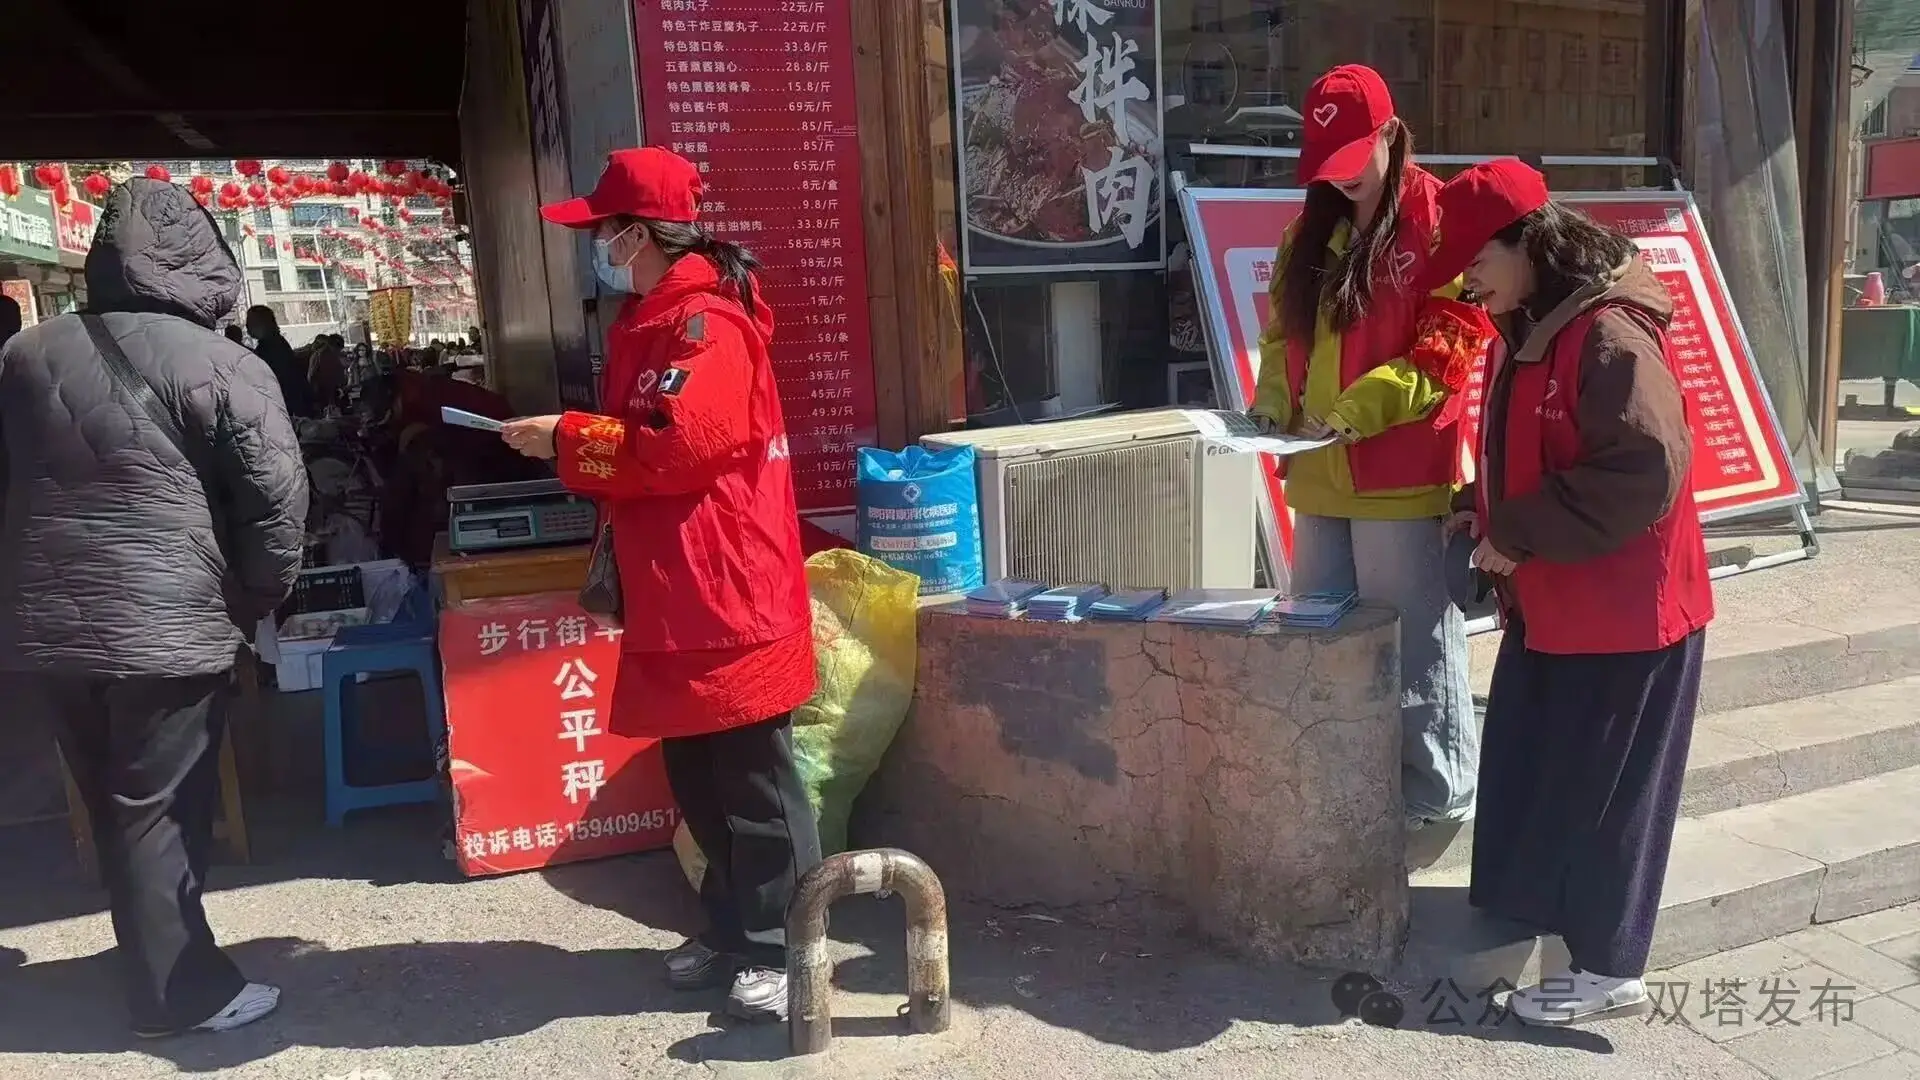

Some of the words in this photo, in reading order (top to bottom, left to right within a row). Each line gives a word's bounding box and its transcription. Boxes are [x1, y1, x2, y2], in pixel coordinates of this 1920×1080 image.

[781, 2, 825, 13] 22元/斤
[662, 20, 759, 32] 特色干炸豆腐丸子
[783, 22, 826, 33] 22元/斤
[663, 40, 724, 52] 特色猪口条
[784, 41, 828, 53] 33.8/斤
[786, 62, 830, 73] 28.8/斤
[787, 81, 831, 93] 15.8/斤
[668, 101, 729, 113] 特色酱牛肉
[789, 101, 832, 113] 69元/斤
[801, 121, 834, 132] 85/斤
[803, 140, 835, 151] 85/斤
[793, 160, 836, 171] 65元/斤
[802, 179, 838, 190] 8元/盒
[696, 201, 726, 213] 皮冻
[802, 199, 838, 210] 9.8/斤
[797, 218, 840, 229] 33.8/斤
[788, 237, 842, 249] 58元/半只
[800, 257, 843, 268] 98元/只
[802, 276, 845, 287] 36.8/斤
[810, 295, 845, 306] 1元/个
[804, 313, 847, 325] 15.8/斤
[808, 351, 850, 362] 45元/斤
[809, 370, 851, 381] 39元/斤
[811, 387, 853, 399] 45元/斤
[811, 406, 854, 417] 49.9/只
[553, 659, 607, 804] 公平秤
[464, 807, 682, 859] 投诉电话:159409451
